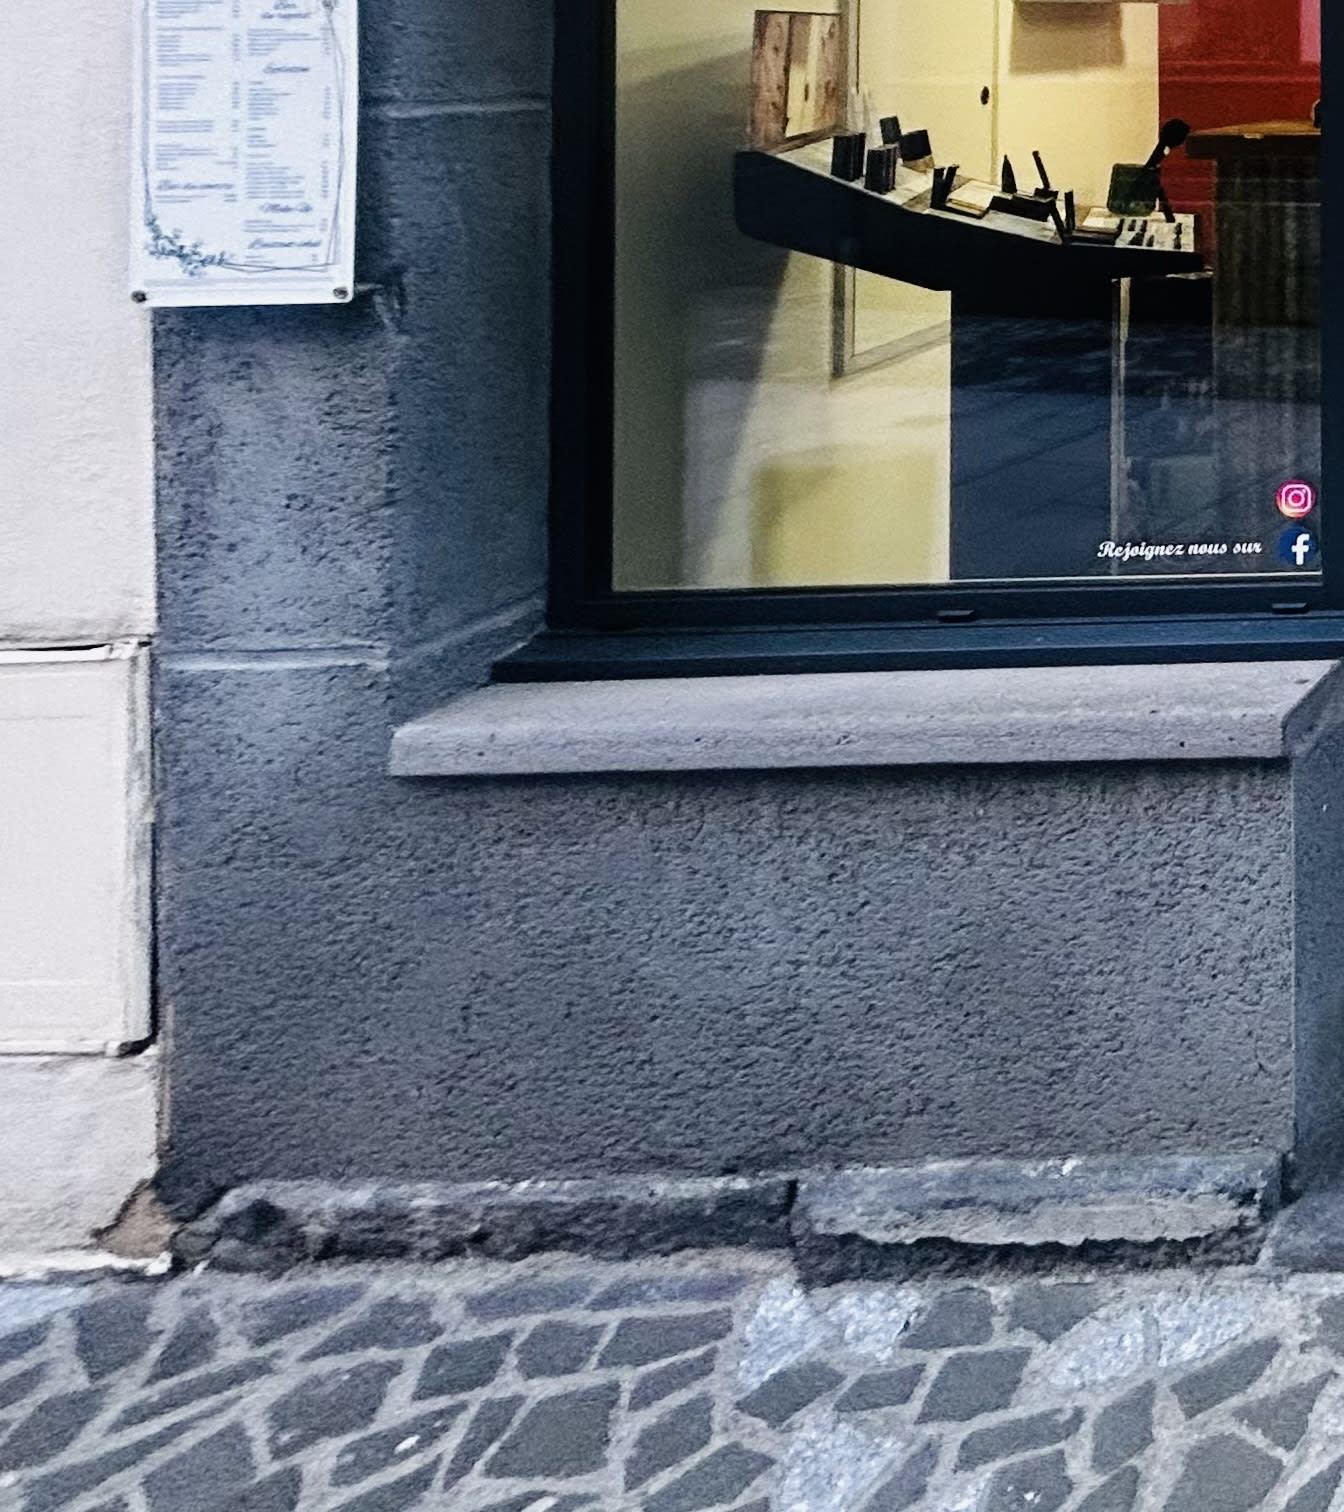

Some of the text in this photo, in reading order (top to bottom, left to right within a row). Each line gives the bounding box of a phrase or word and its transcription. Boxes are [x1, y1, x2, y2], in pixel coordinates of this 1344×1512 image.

[1096, 541, 1263, 561] Rejoignez nous sur
